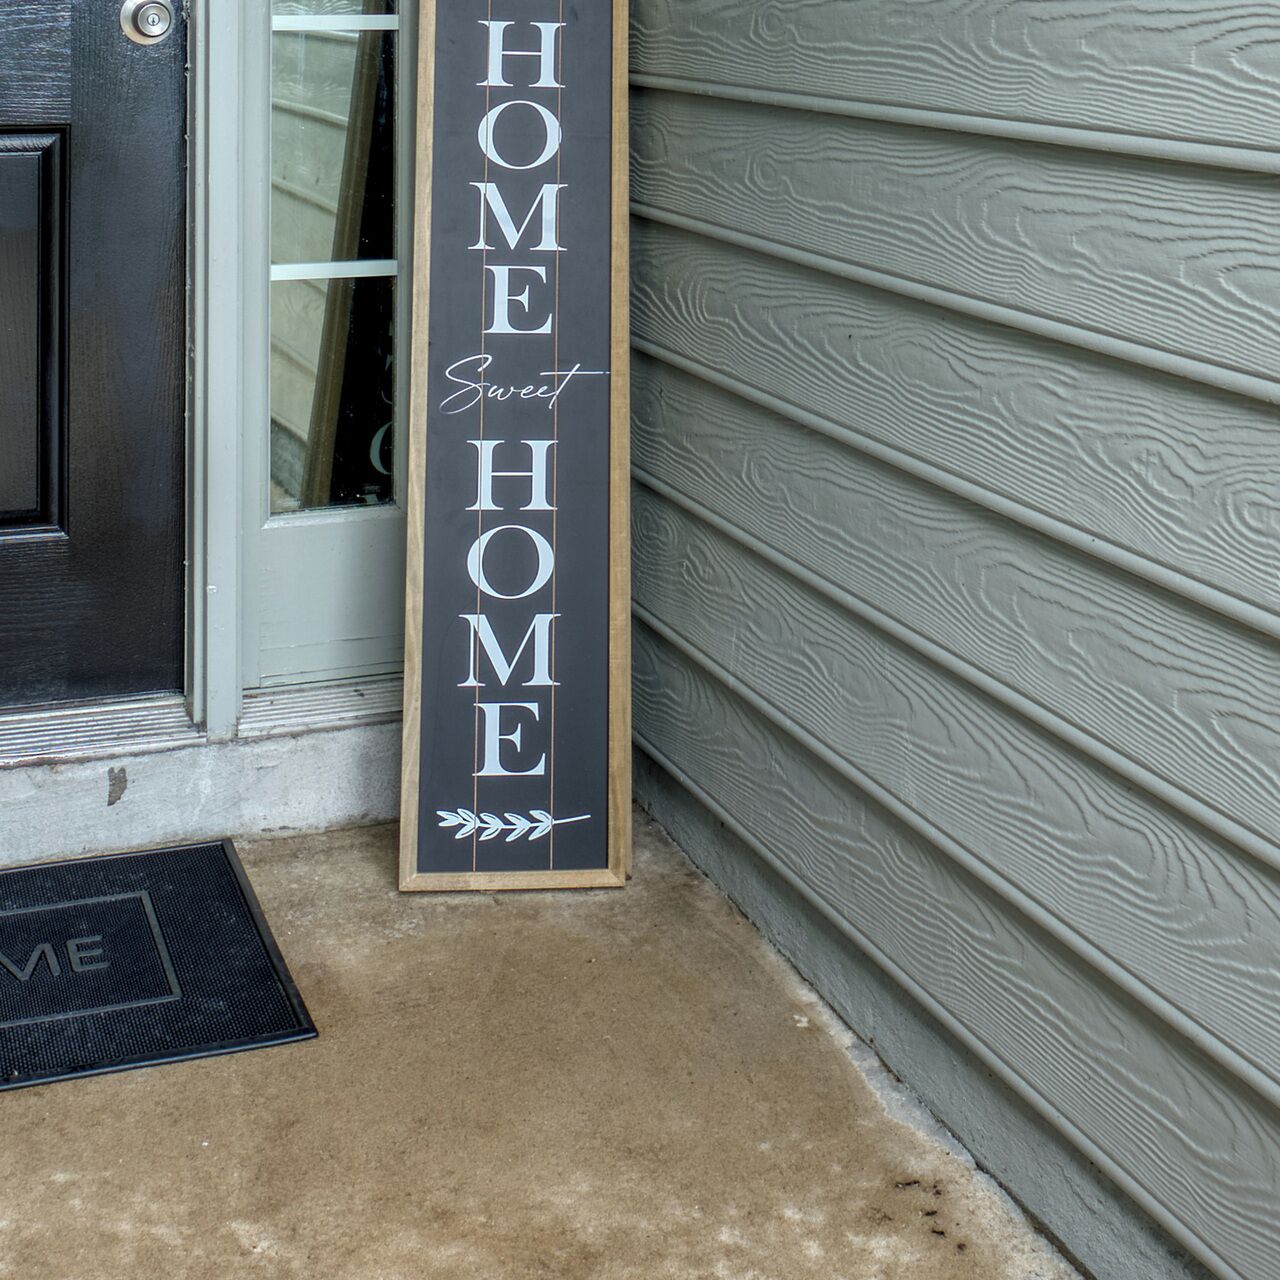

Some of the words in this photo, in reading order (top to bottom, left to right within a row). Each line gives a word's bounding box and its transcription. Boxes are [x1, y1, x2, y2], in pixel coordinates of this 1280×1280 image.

[467, 20, 569, 335] HOME
[439, 354, 611, 415] Sweet
[457, 439, 562, 777] HOME
